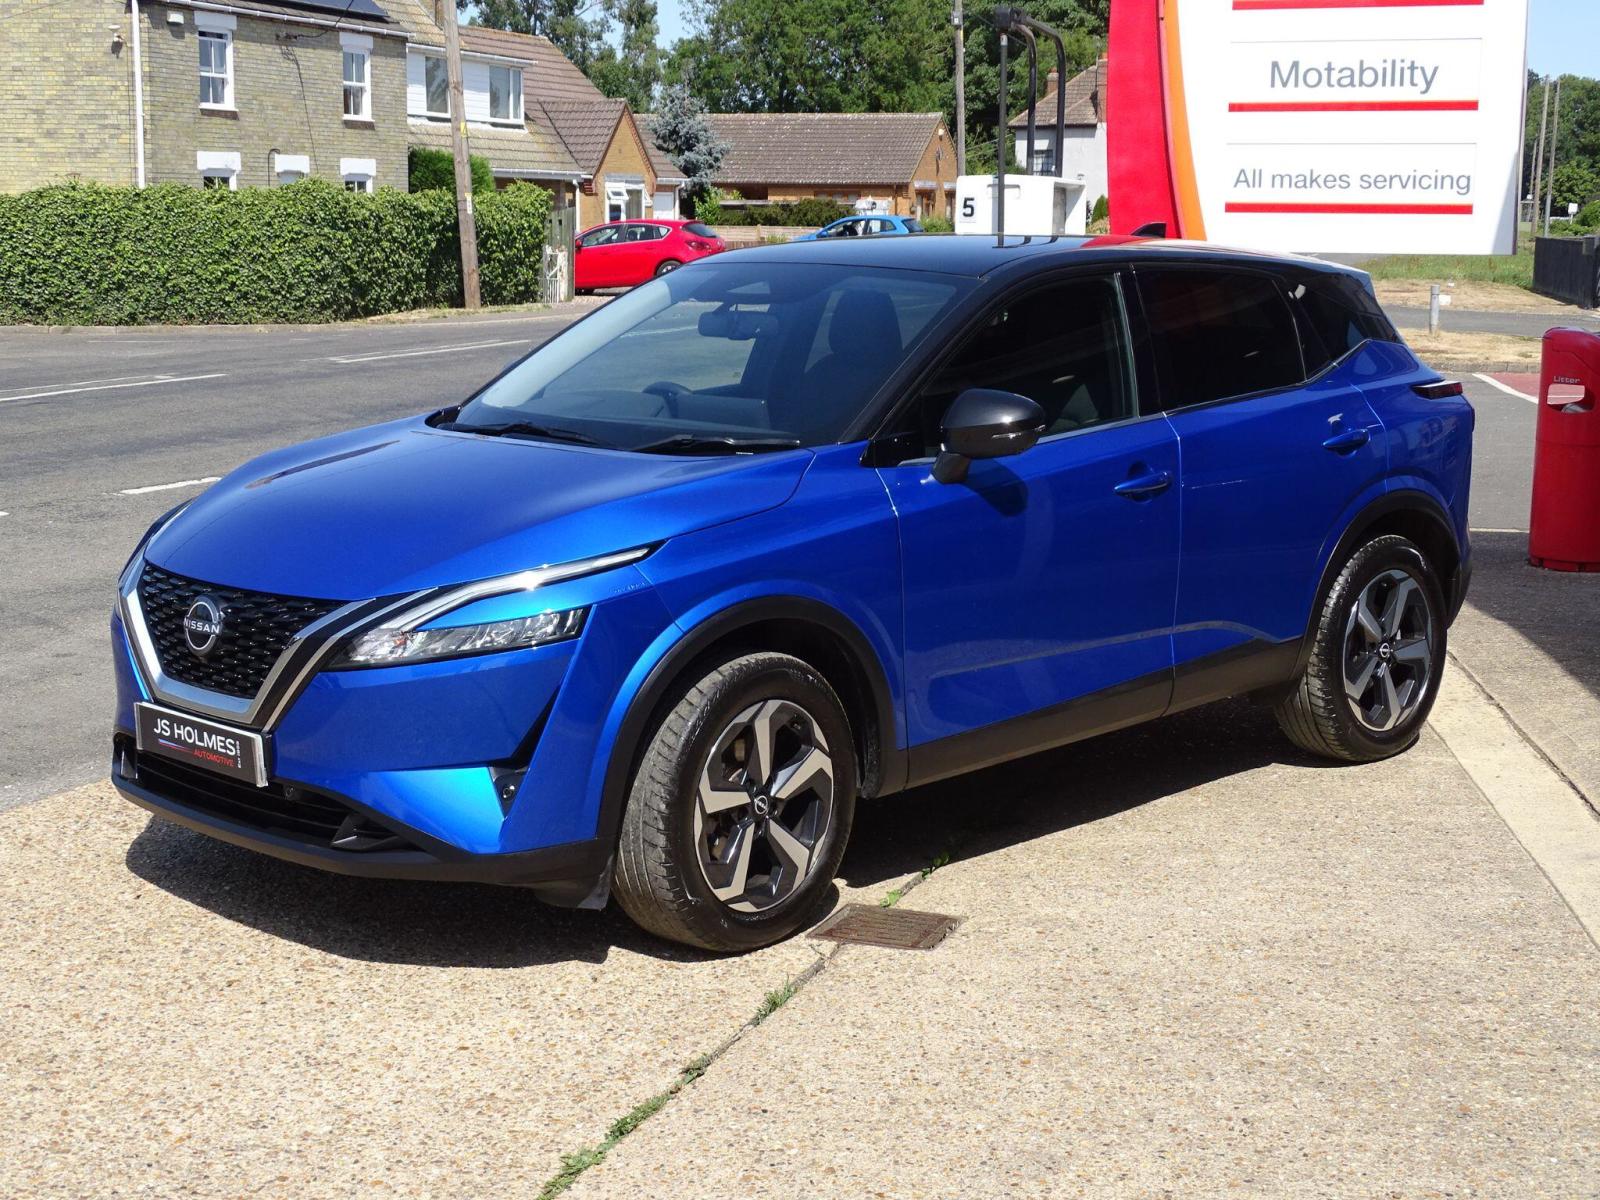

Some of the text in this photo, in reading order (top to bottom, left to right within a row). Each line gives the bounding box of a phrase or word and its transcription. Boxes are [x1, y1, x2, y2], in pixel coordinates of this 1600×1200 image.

[1269, 59, 1439, 95] Motability
[1233, 168, 1472, 196] All makes servicing
[962, 197, 975, 218] 5
[184, 616, 220, 634] NISSAN
[153, 718, 171, 737] JS
[173, 722, 236, 756] HOLMES
[193, 748, 235, 768] AUTOMOTIVE
